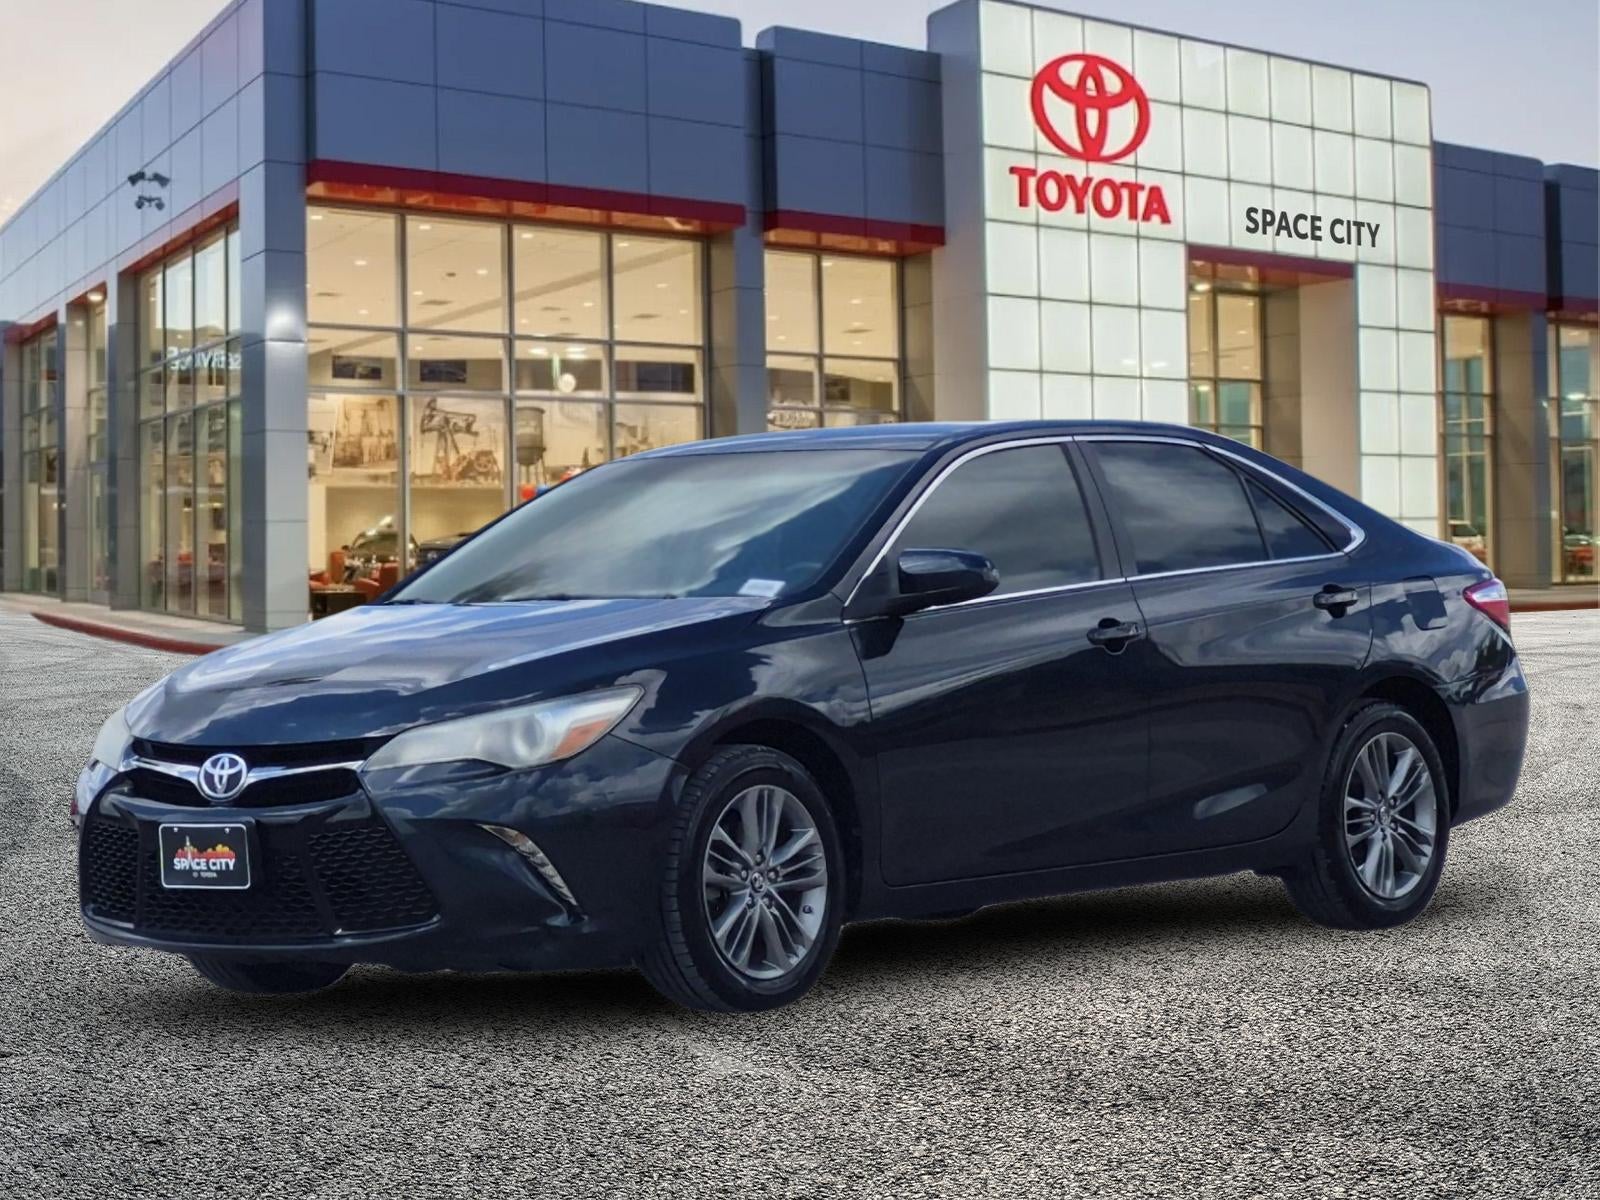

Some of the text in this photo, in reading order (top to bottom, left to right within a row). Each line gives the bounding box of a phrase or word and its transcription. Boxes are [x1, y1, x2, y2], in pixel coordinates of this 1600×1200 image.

[1009, 166, 1171, 225] TOYOTA
[1245, 206, 1381, 248] SPACE CITY
[173, 858, 235, 870] SPACE CITY
